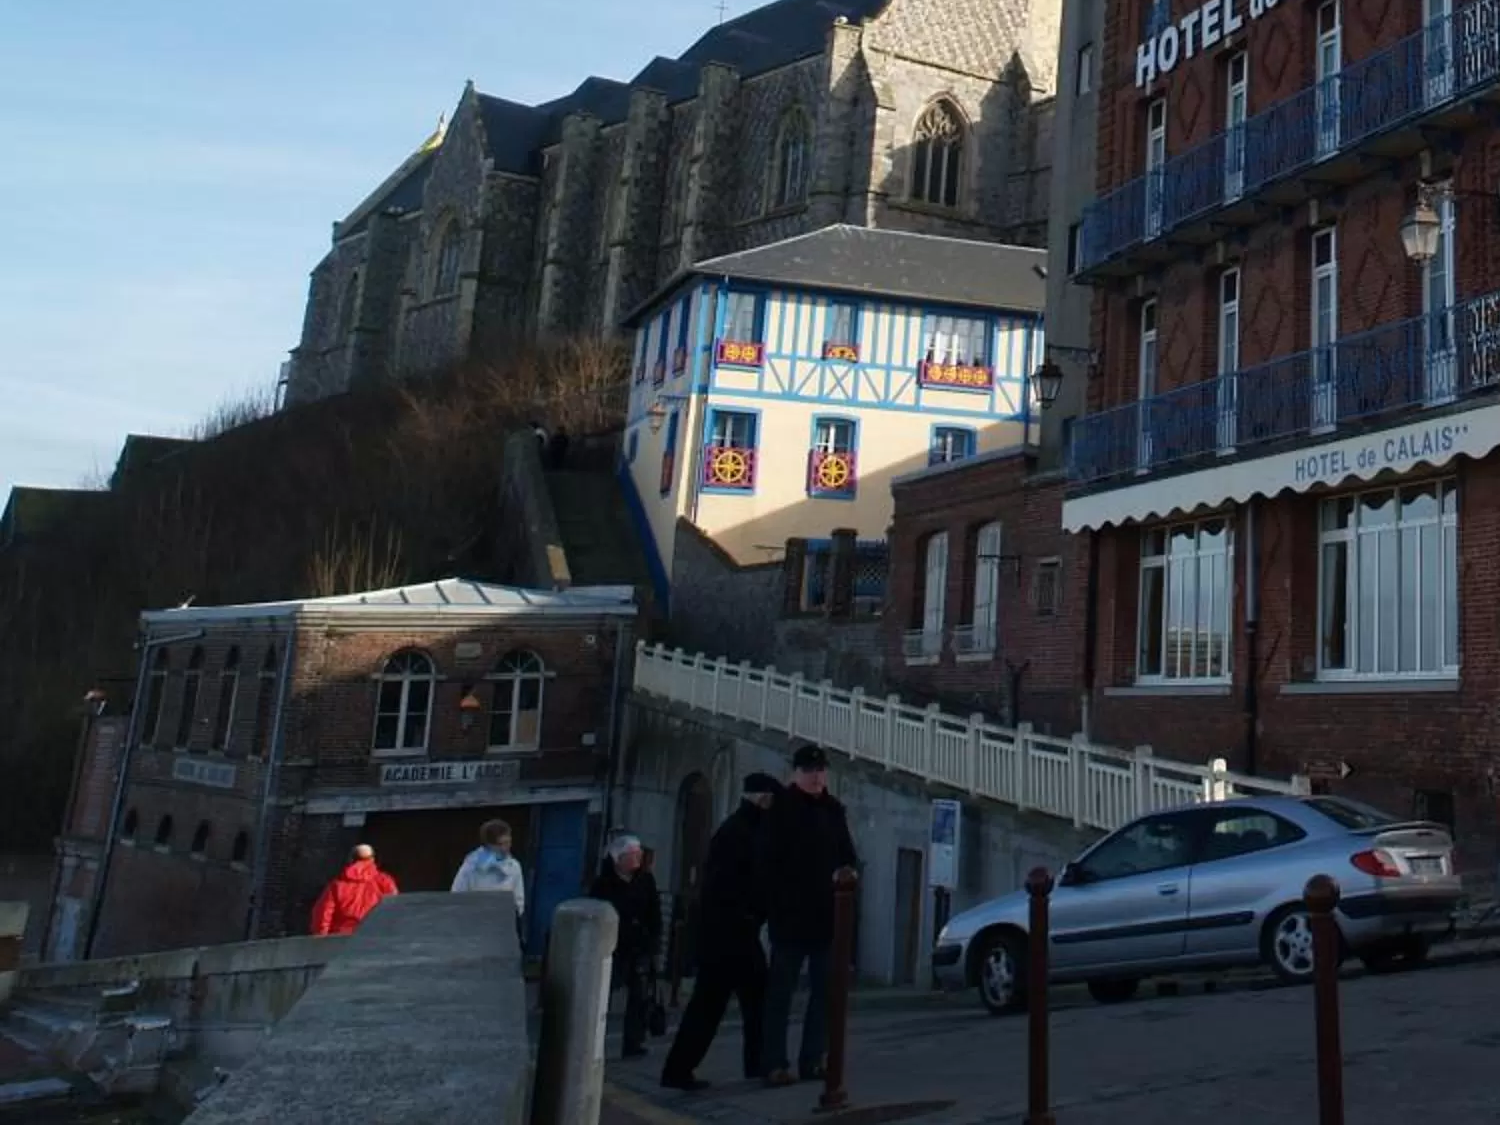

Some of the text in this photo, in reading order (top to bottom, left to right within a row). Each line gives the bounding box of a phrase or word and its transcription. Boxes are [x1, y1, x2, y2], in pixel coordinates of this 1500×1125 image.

[1295, 426, 1454, 482] HOTEL de CALAIS
